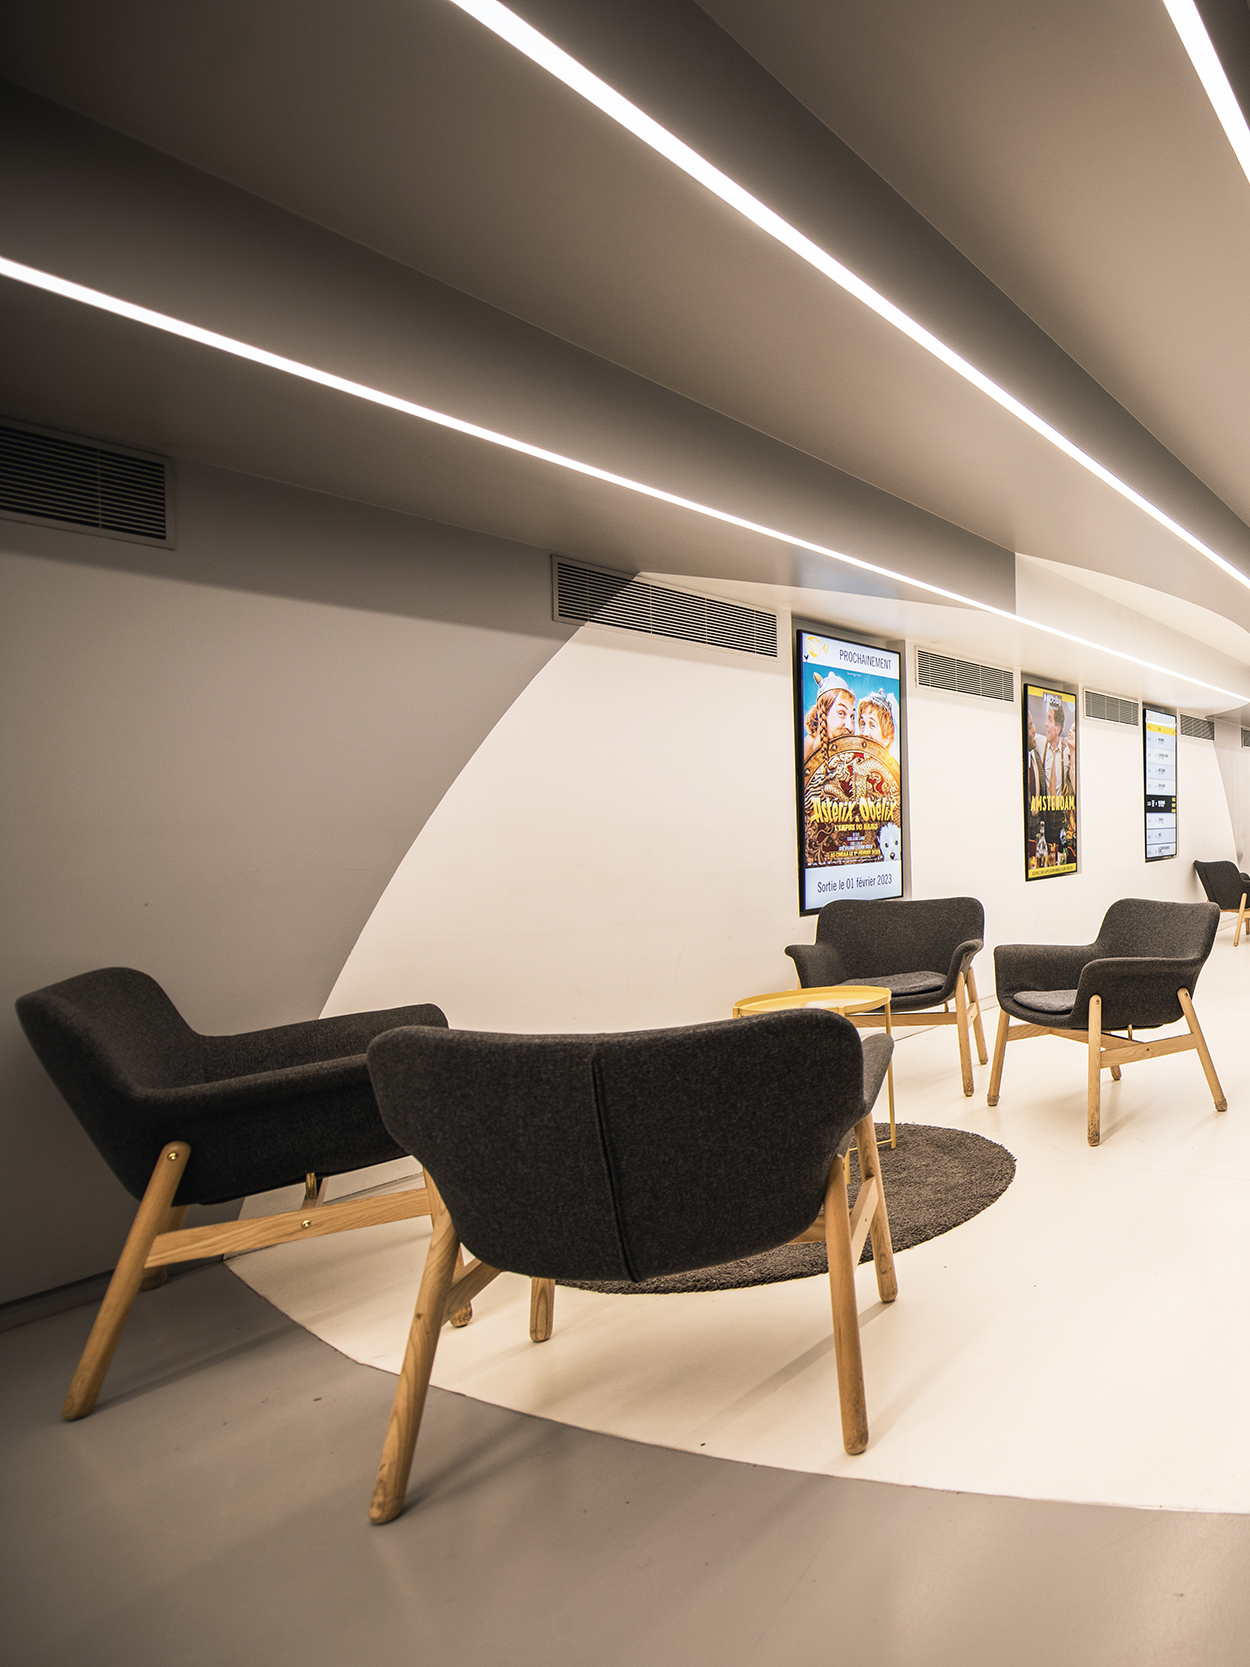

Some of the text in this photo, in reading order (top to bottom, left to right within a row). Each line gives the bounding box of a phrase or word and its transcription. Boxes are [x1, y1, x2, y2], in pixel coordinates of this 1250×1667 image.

[839, 649, 892, 670] PROCHAINEMENT
[1030, 795, 1075, 811] AMSTERDAM
[817, 873, 893, 893] Sortie le 01 février 2023
